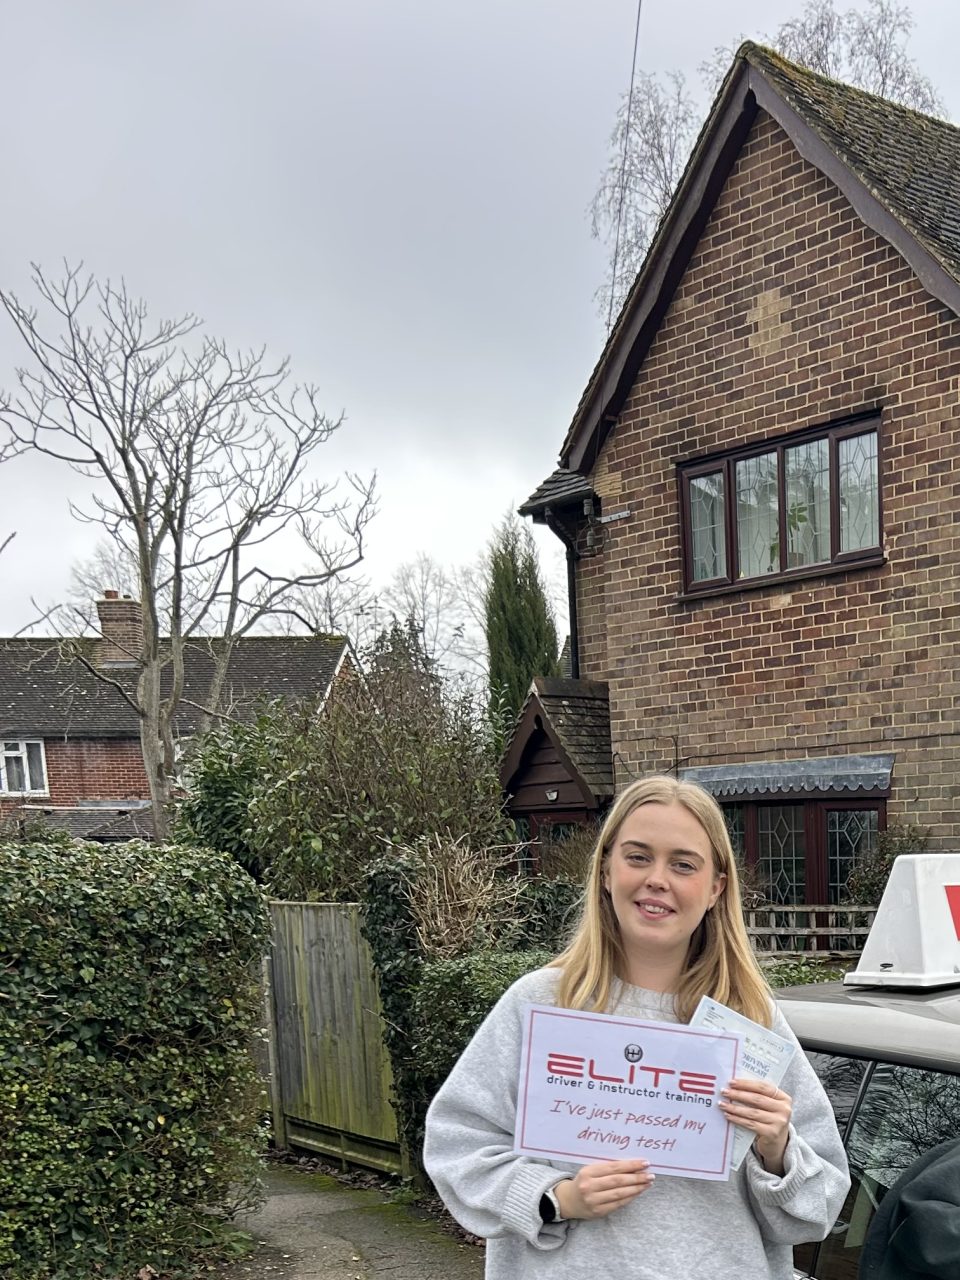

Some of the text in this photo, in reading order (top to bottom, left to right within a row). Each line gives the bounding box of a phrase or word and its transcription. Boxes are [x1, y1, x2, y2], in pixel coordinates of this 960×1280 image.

[546, 1075, 712, 1108] driver & instructor training
[550, 1099, 707, 1135] I've just passed my
[577, 1126, 677, 1152] driving test!
